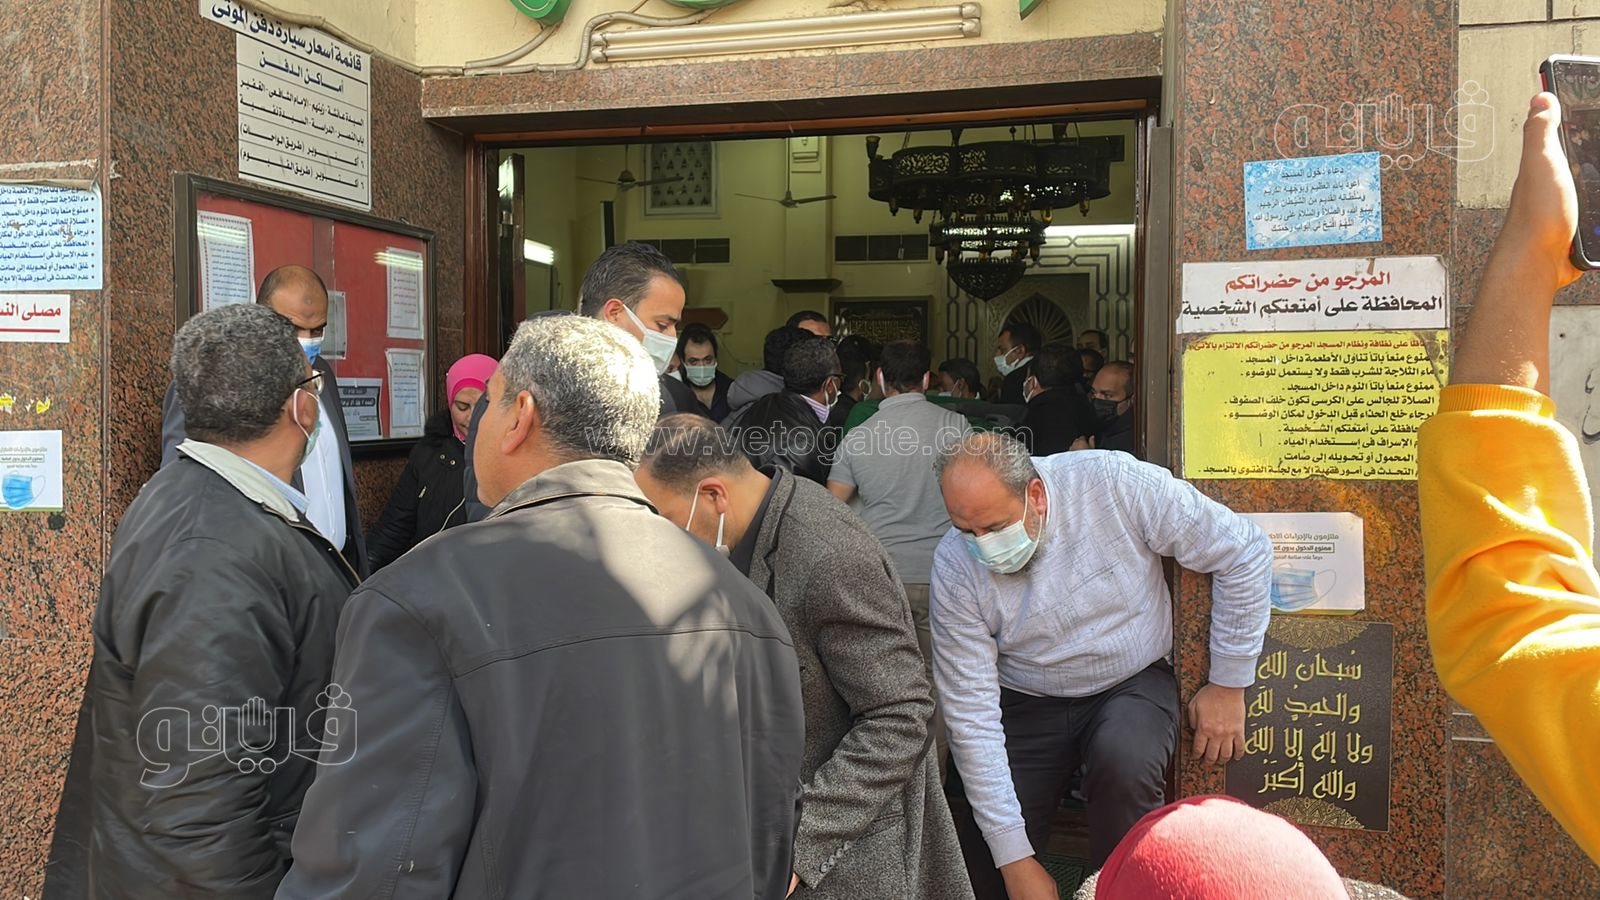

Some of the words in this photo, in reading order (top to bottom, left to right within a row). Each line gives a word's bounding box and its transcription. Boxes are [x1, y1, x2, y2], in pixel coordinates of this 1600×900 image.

[211, 0, 248, 25] الموتى
[249, 11, 275, 35] دفن
[275, 20, 306, 50] سيارة
[305, 42, 334, 61] أسعار
[259, 50, 303, 78] الدفن
[335, 45, 362, 72] قائمة
[1225, 273, 1302, 294] حضراتكم
[1305, 273, 1329, 292] من
[1331, 271, 1391, 291] المرجو
[1182, 298, 1257, 319] الشخصية
[1259, 296, 1321, 318] أمتعتكم
[1324, 298, 1358, 317] على
[1361, 295, 1442, 311] المحافظة
[21, 303, 61, 321] مصلى
[1244, 341, 1277, 351] حضراتكم
[1279, 341, 1291, 351] من
[1292, 341, 1315, 350] المرجو
[1316, 340, 1345, 350] المسجد
[1346, 340, 1368, 350] ونظام
[1369, 339, 1393, 348] نظافة
[1393, 340, 1408, 350] على
[1281, 353, 1303, 365] داخل
[1343, 352, 1368, 364] تناول
[1278, 367, 1313, 378] يستعمل
[1315, 367, 1328, 378] ولا
[1330, 367, 1350, 375] فقط
[1352, 366, 1383, 378] للشرب
[1384, 366, 1419, 378] الثلاجة
[1321, 382, 1344, 392] داخل
[1346, 381, 1368, 392] النوم
[1405, 381, 1434, 393] ممنوع
[1265, 395, 1286, 405] خلف
[1287, 395, 1309, 406] تكون
[1311, 395, 1345, 406] الكرسى
[1346, 395, 1364, 406] على
[1366, 395, 1400, 406] للجالس
[1402, 395, 1434, 405] الصلاة
[1281, 409, 1305, 420] لمكان
[1307, 410, 1340, 420] الدخول
[1341, 409, 1359, 420] قبل
[1360, 409, 1388, 419] الحذاء
[1389, 410, 1407, 421] خلع
[1335, 422, 1369, 435] أمتعتكم
[1370, 424, 1389, 434] على
[1362, 437, 1376, 448] فى
[1376, 437, 1412, 449] الإسراف
[1312, 453, 1326, 465] إلى
[1328, 452, 1364, 464] تحويله
[1366, 452, 1374, 464] أو
[1375, 452, 1414, 464] المحمول
[1239, 465, 1267, 475] الفتوى
[1290, 467, 1302, 477] مع
[1340, 466, 1363, 477] أمور
[1363, 467, 1376, 477] فى
[1377, 466, 1414, 477] التحدث
[1257, 650, 1288, 680] الله
[1244, 724, 1275, 755] الله
[1346, 731, 1374, 765] ولا
[1312, 769, 1357, 801] والله
